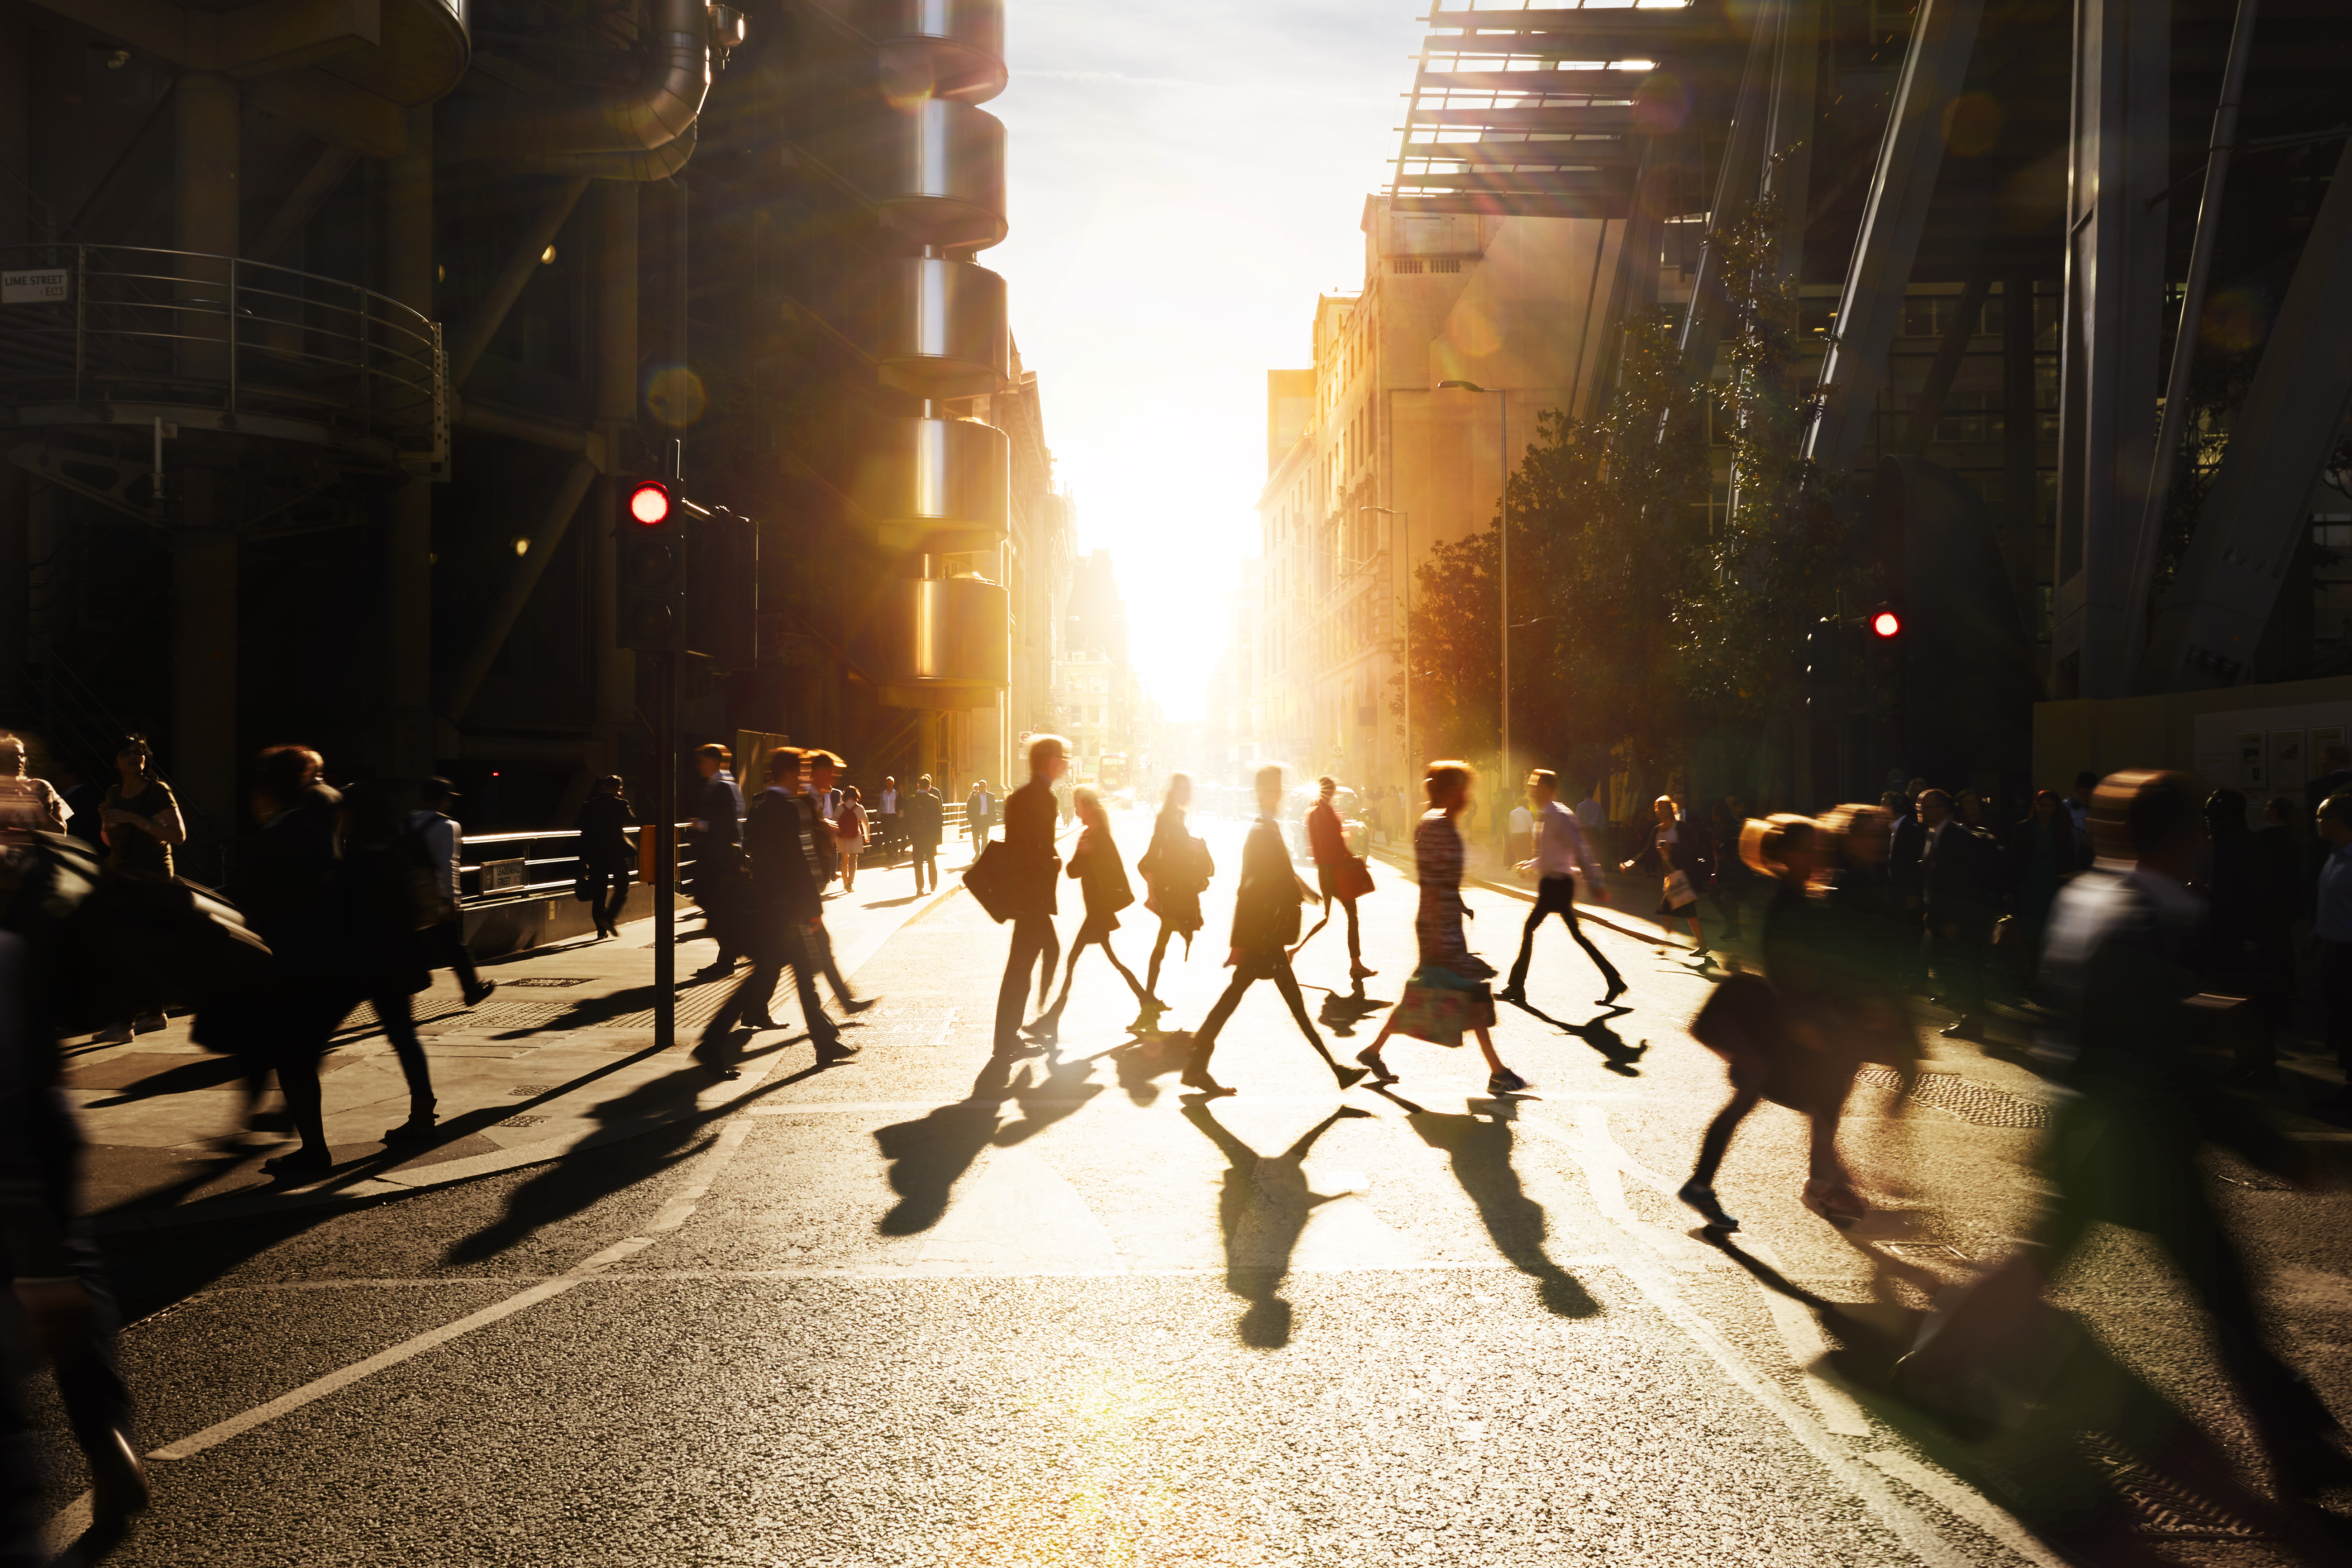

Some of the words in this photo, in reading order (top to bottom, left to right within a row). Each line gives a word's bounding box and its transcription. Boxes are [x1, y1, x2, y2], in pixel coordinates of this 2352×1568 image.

[5, 276, 27, 286] LIME
[30, 275, 63, 285] STREET
[45, 286, 63, 295] EC3
[497, 865, 521, 876] LEADENHALL
[497, 877, 510, 886] STREET
